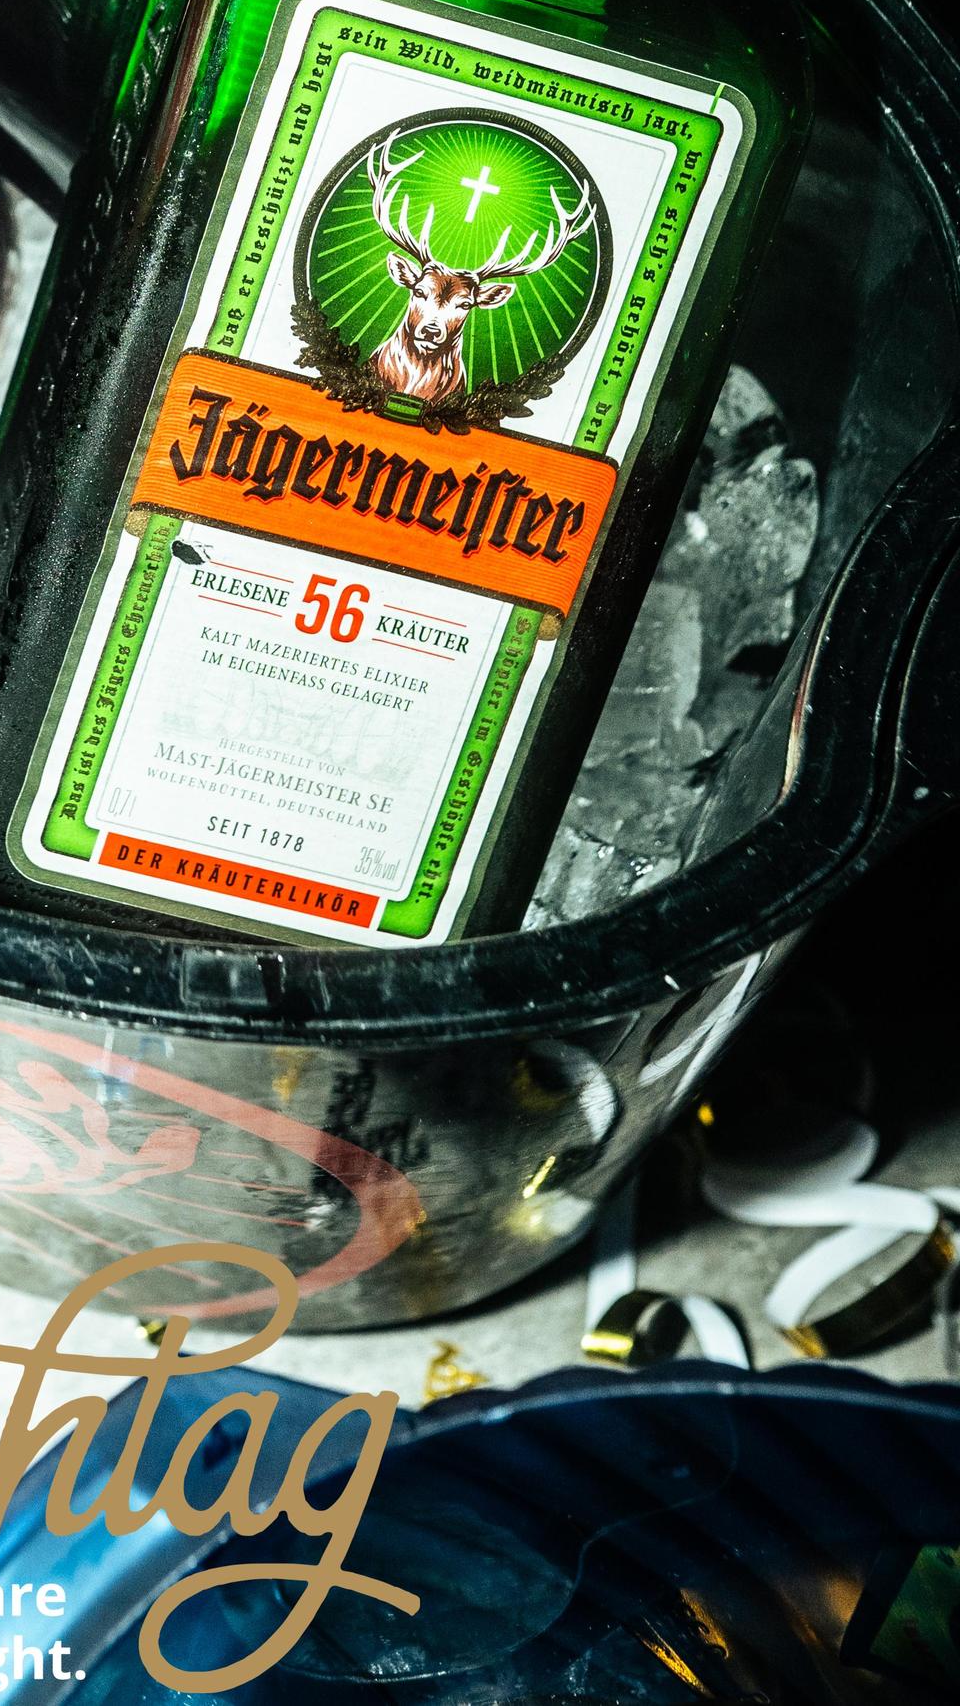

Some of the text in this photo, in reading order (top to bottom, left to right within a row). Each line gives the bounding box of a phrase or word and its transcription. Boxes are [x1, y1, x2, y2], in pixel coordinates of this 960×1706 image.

[302, 41, 333, 93] hegt
[337, 25, 695, 141] sein Wild, weidmännisch jagt,
[289, 103, 312, 146] und
[674, 149, 703, 195] wie
[245, 155, 295, 265] beschützt
[239, 274, 255, 298] er
[602, 293, 647, 386] gehört,
[583, 400, 613, 445] den
[168, 385, 588, 567] Jägermeister
[190, 569, 471, 654] ERLESENE 56 KRÄUTER
[96, 643, 131, 713] Jägers
[200, 626, 430, 695] KALT MAZERIERTES ELIXIER
[202, 649, 415, 714] IM EICHENFASS GELAGERT
[87, 714, 108, 748] des
[475, 716, 498, 743] im
[81, 749, 96, 777] ist
[218, 736, 347, 777] HERGESTELLT VON
[59, 781, 86, 822] Das
[146, 766, 389, 835] WOLFENBÜTTEL, DEUTSCHLAND
[366, 792, 396, 815] SE
[207, 815, 306, 853] SEIT 1878
[117, 843, 362, 917] DER KRÄUTERLIKÖR
